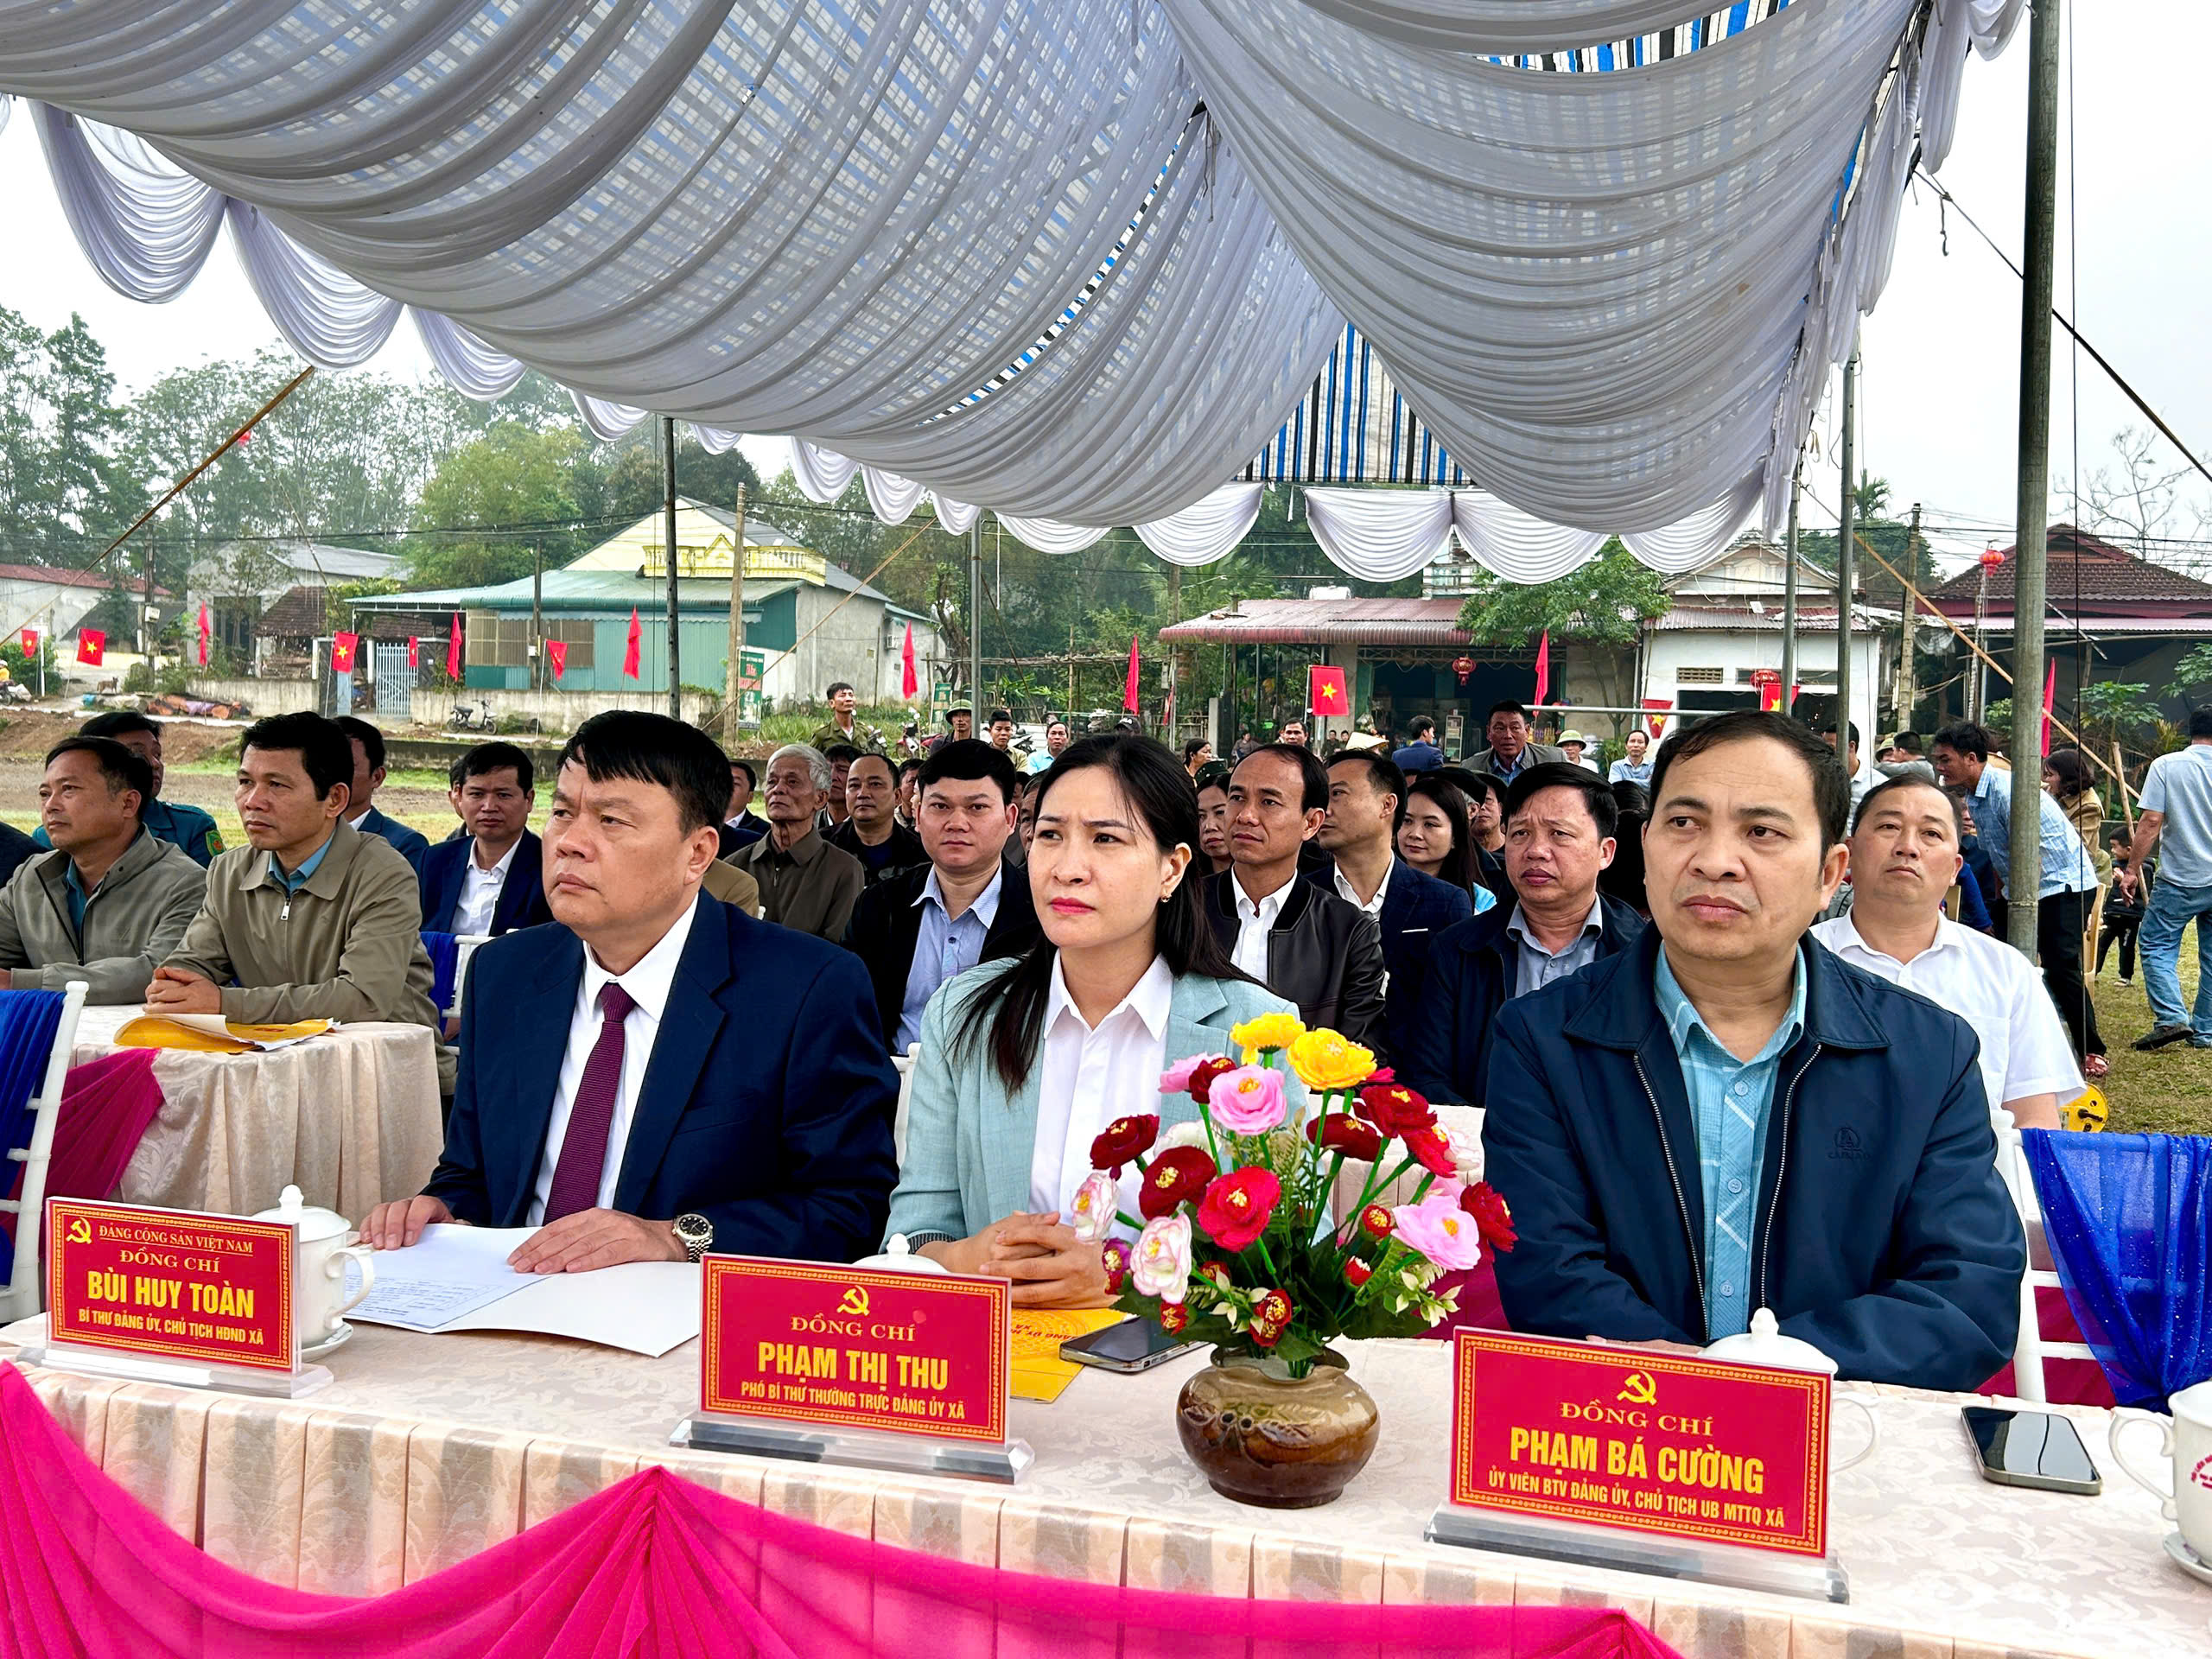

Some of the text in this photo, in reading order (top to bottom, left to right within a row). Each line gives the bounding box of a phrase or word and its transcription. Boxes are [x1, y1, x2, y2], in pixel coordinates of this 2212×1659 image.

[99, 1224, 252, 1252] ĐẢNG CỘNG SẢN VIỆT NAM
[120, 1247, 220, 1273] ĐỒNG CHÍ
[88, 1265, 253, 1319] BÙI HUY TOÀN
[79, 1308, 264, 1345] BÍ THƯ ĐẢNG ỦY, CHỦ TỊCH HĐND XÃ
[791, 1313, 916, 1341] ĐỒNG CHÍ
[758, 1342, 948, 1390] PHẠM THỊ THU
[741, 1380, 965, 1419] PHÓ BÍ THƯ THƯỜNG TRỰC ĐẢNG ỦY XÃ
[1560, 1398, 1713, 1436] ĐỒNG CHÍ
[1510, 1427, 1763, 1494] PHẠM BÁ CƯỜNG
[1489, 1465, 1783, 1529] ỦY VIÊN BTV ĐẢNG ỦY, CHỦ TỊCH UB MTTQ XÃ
